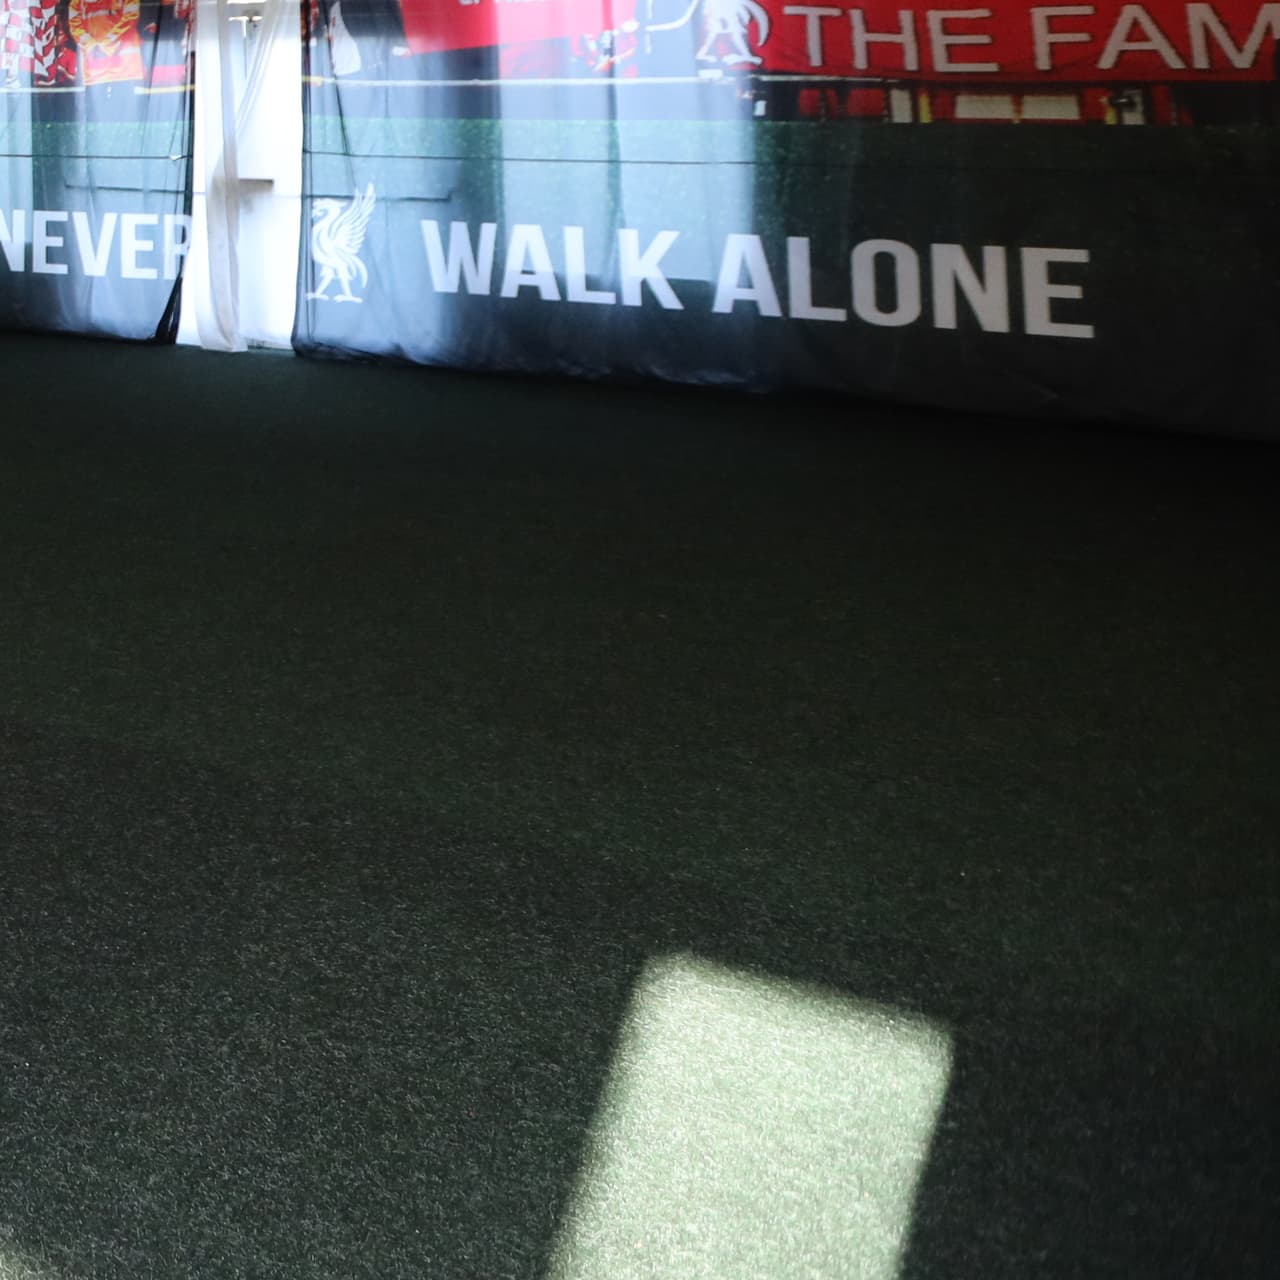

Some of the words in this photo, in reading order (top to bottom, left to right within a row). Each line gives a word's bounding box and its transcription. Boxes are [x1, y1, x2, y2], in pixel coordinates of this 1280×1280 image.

[782, 5, 1000, 73] THE
[419, 219, 685, 311] WALK
[711, 234, 1096, 339] ALONE
